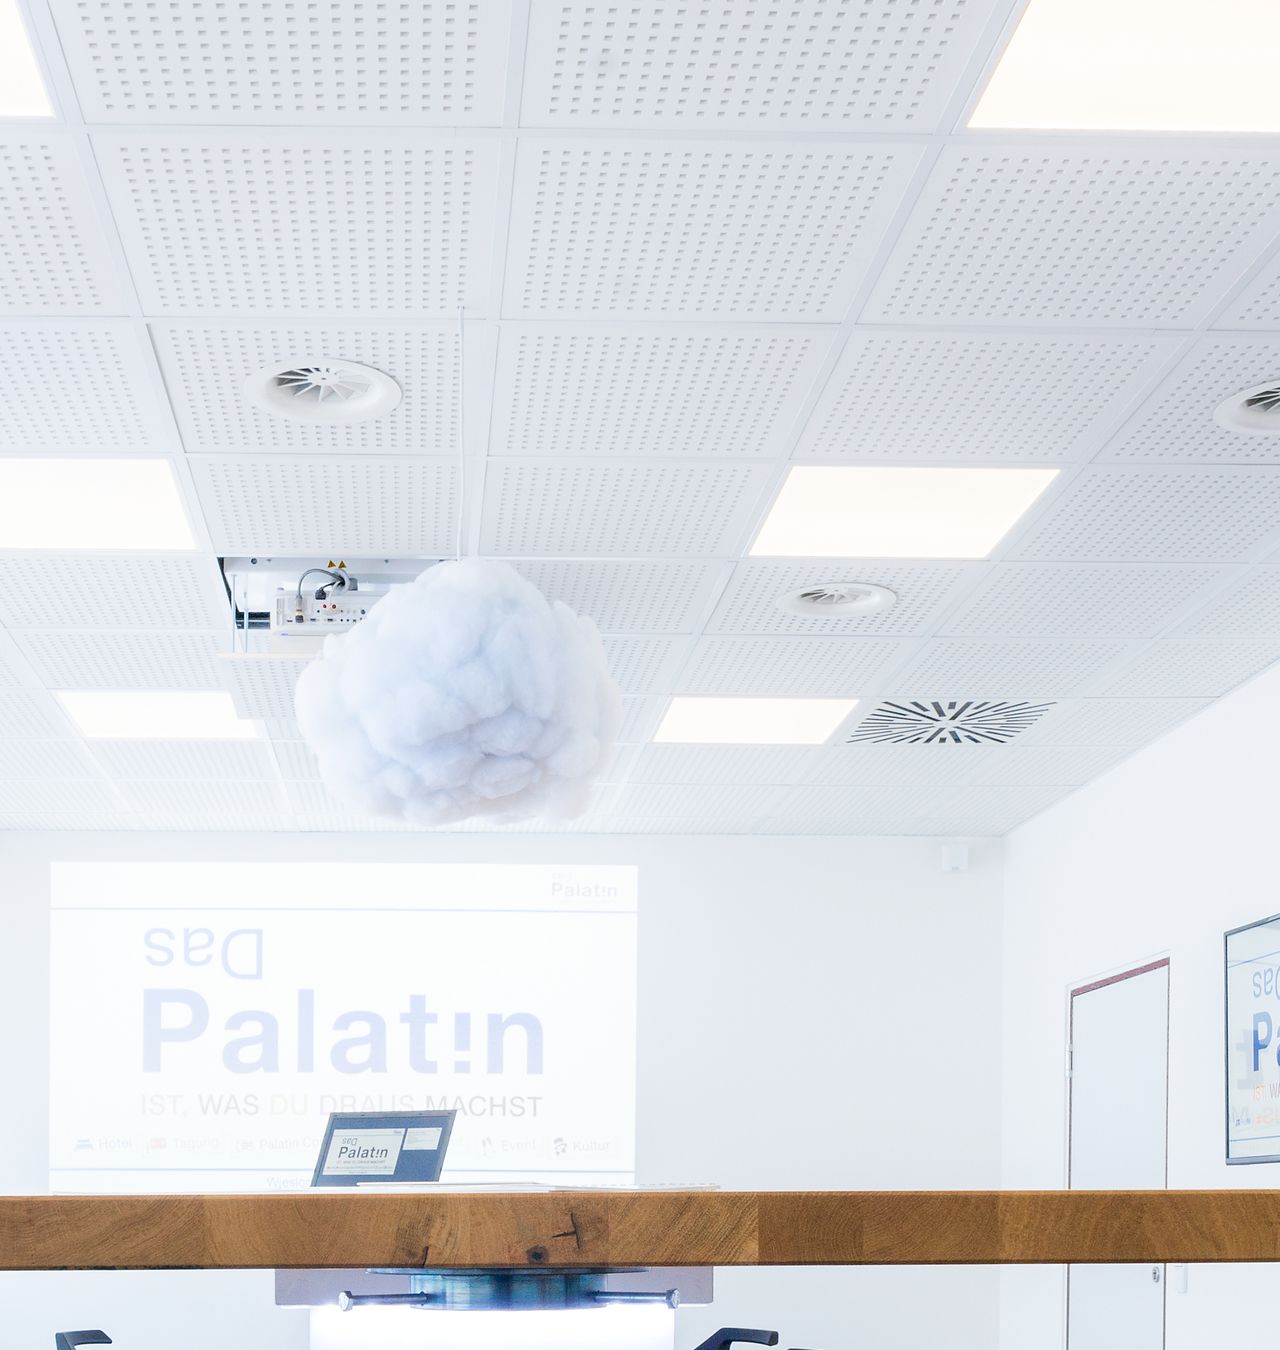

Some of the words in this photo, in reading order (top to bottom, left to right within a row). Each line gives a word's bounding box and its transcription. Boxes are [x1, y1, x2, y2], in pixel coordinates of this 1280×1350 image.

[143, 927, 264, 980] Das
[197, 1094, 260, 1116] WAS
[270, 1094, 310, 1116] DU
[426, 1095, 542, 1117] MACHST
